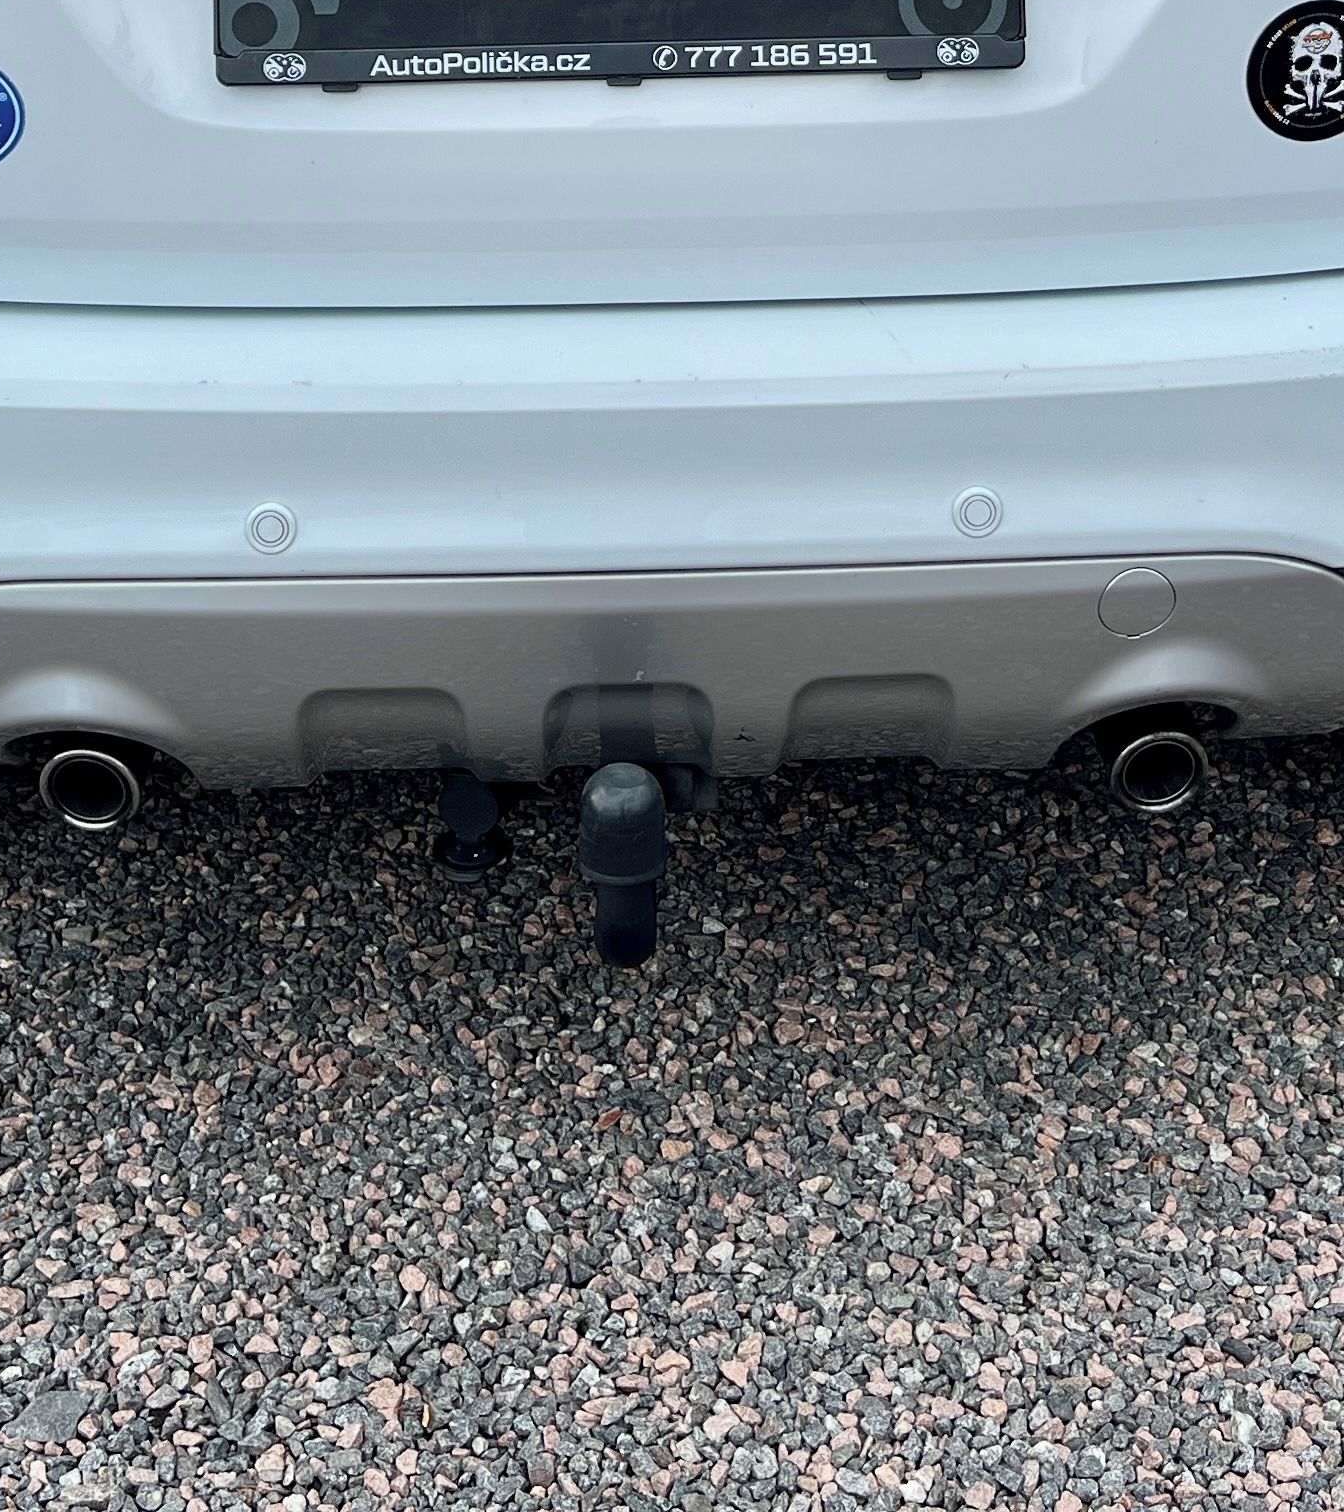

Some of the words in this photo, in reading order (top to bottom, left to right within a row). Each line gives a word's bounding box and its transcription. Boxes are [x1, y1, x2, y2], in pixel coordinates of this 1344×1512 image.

[369, 50, 591, 77] AutoPolička.cz
[684, 46, 739, 68] 777
[751, 45, 810, 66] 186
[818, 43, 878, 65] 591
